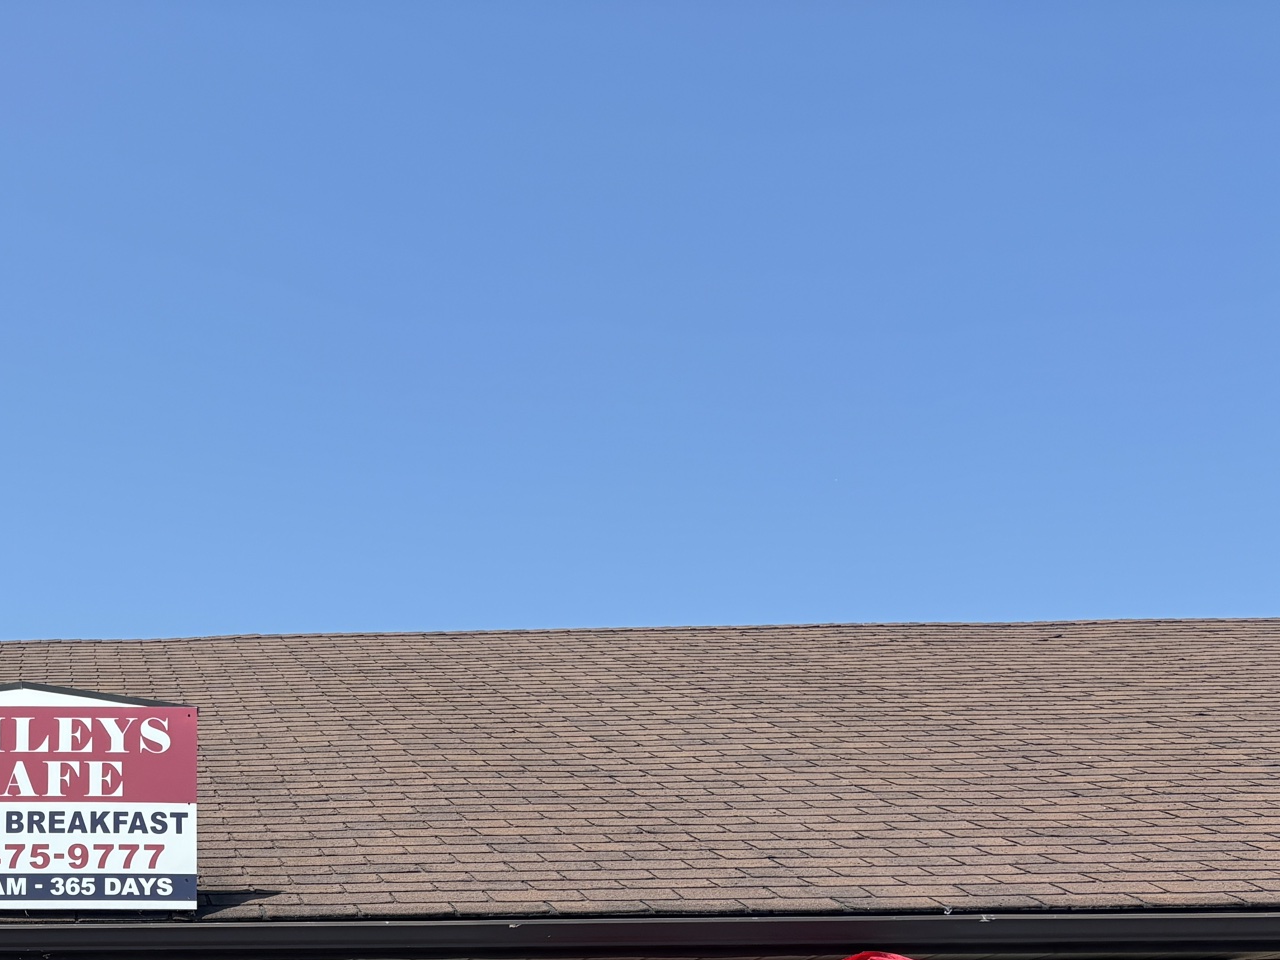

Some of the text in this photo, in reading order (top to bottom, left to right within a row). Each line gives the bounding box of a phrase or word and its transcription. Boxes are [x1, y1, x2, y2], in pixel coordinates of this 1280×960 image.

[5, 811, 189, 835] BREAKFAST
[50, 877, 96, 896] 365
[104, 877, 174, 896] DAYS
